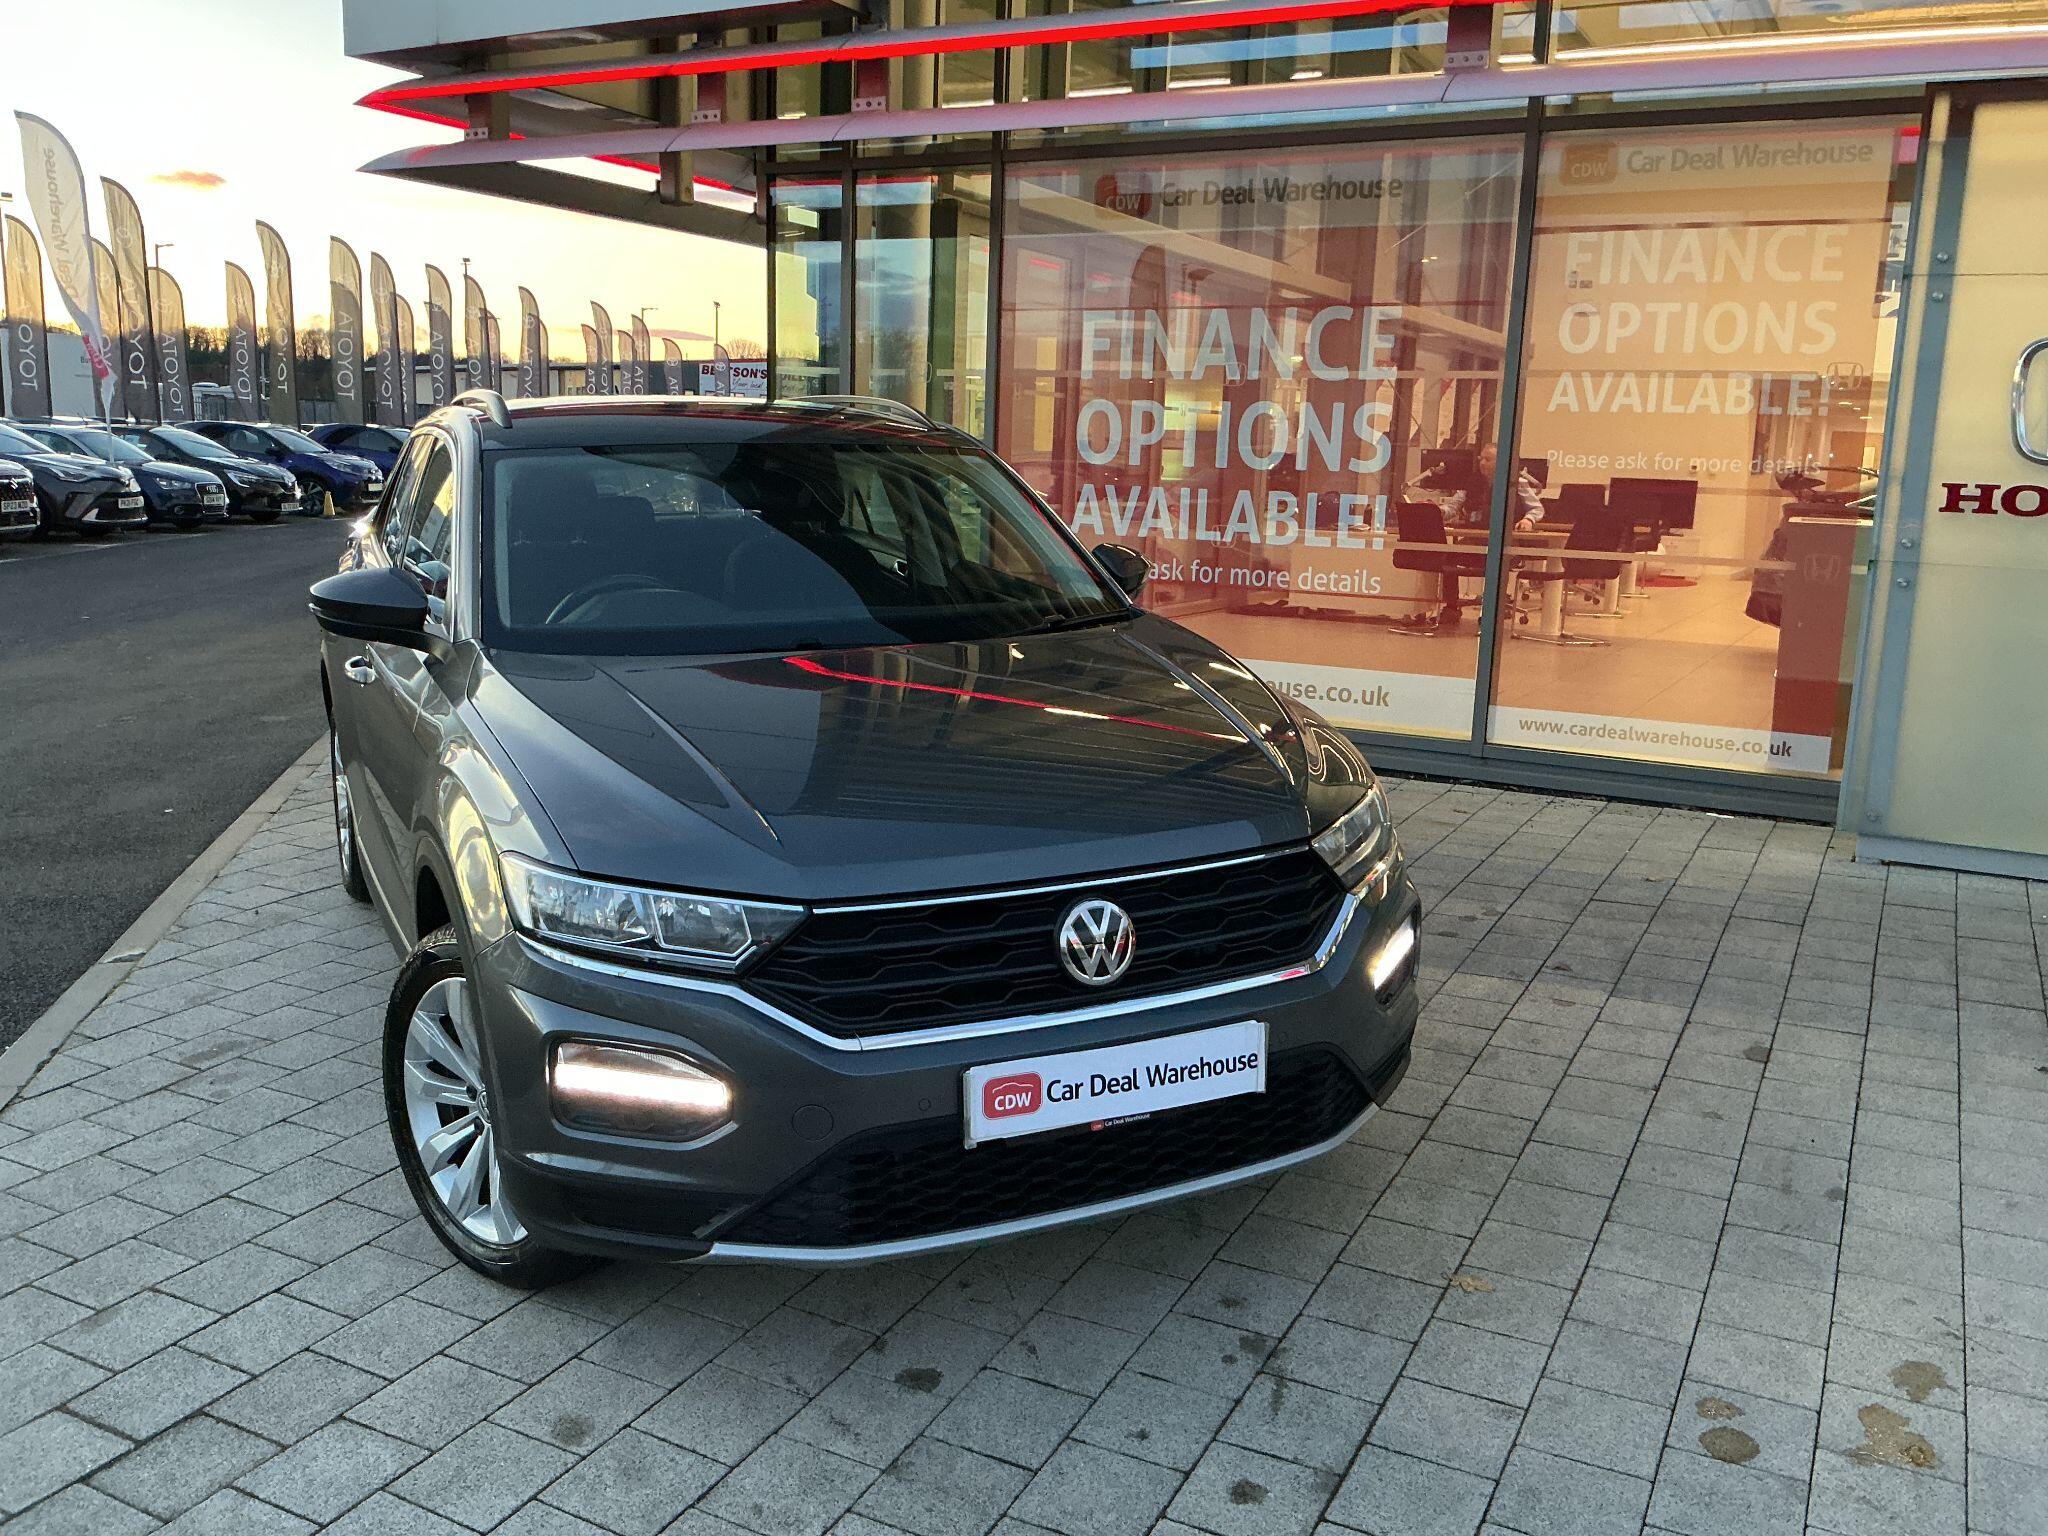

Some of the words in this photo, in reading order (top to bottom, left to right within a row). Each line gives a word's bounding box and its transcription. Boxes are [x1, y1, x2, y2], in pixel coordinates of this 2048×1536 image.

[1570, 160, 1607, 178] CDW
[1627, 150, 1664, 174] Car
[1671, 147, 1723, 172] Deal
[1733, 142, 1874, 168] Warehouse
[1105, 193, 1141, 211] CDW
[1162, 182, 1197, 207] Car
[1202, 178, 1255, 205] Deal
[1263, 175, 1403, 203] Warehouse
[1564, 224, 1847, 285] FINANCE
[1079, 305, 1403, 381] FINANCE
[1558, 301, 1838, 355] OPTIONS
[1546, 372, 1832, 417] AVAILABLE!
[1075, 400, 1392, 474] OPTIONS
[1547, 450, 1608, 469] Please
[1616, 453, 1648, 470] ask
[1654, 452, 1683, 471] for
[1690, 457, 1741, 473] more
[1749, 454, 1822, 476] details
[1070, 485, 1388, 550] AVAILABLE!
[1148, 558, 1184, 581] ask
[1190, 559, 1223, 583] for
[1230, 567, 1290, 588] more
[1298, 566, 1381, 594] details
[1519, 718, 1792, 758] www.cardealwarehouse.co.uk
[1047, 1080, 1084, 1103] Car
[1090, 1068, 1140, 1097] Deal
[1146, 1052, 1258, 1088] Warehouse
[994, 1091, 1032, 1112] CDW
